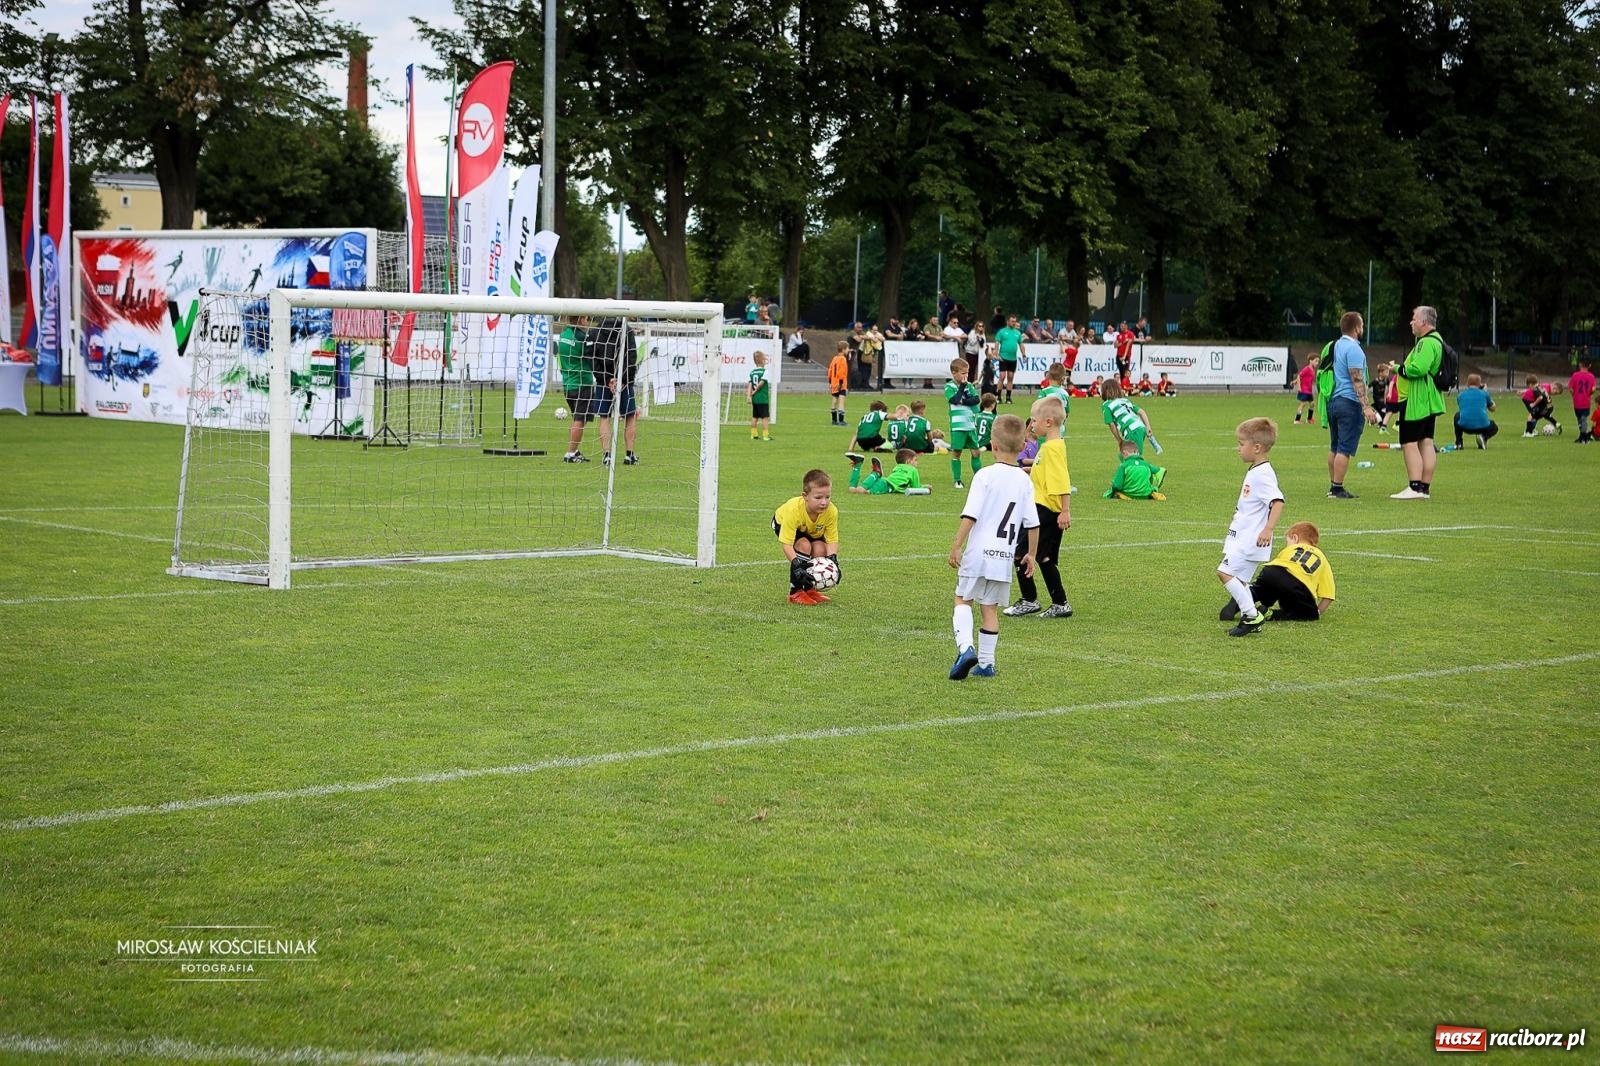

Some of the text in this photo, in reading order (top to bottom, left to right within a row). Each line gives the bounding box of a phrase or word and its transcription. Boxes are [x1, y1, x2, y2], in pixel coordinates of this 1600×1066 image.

[462, 120, 494, 141] RV
[494, 217, 502, 282] SPORT
[460, 202, 471, 345] VAESSA
[527, 314, 550, 396] RACIBÓ
[1017, 356, 1047, 372] MKS
[1084, 356, 1137, 372] Racibz
[890, 424, 899, 440] 9
[909, 418, 919, 433] 5
[979, 419, 987, 435] 6
[996, 501, 1017, 546] 4
[1290, 547, 1322, 575] 10
